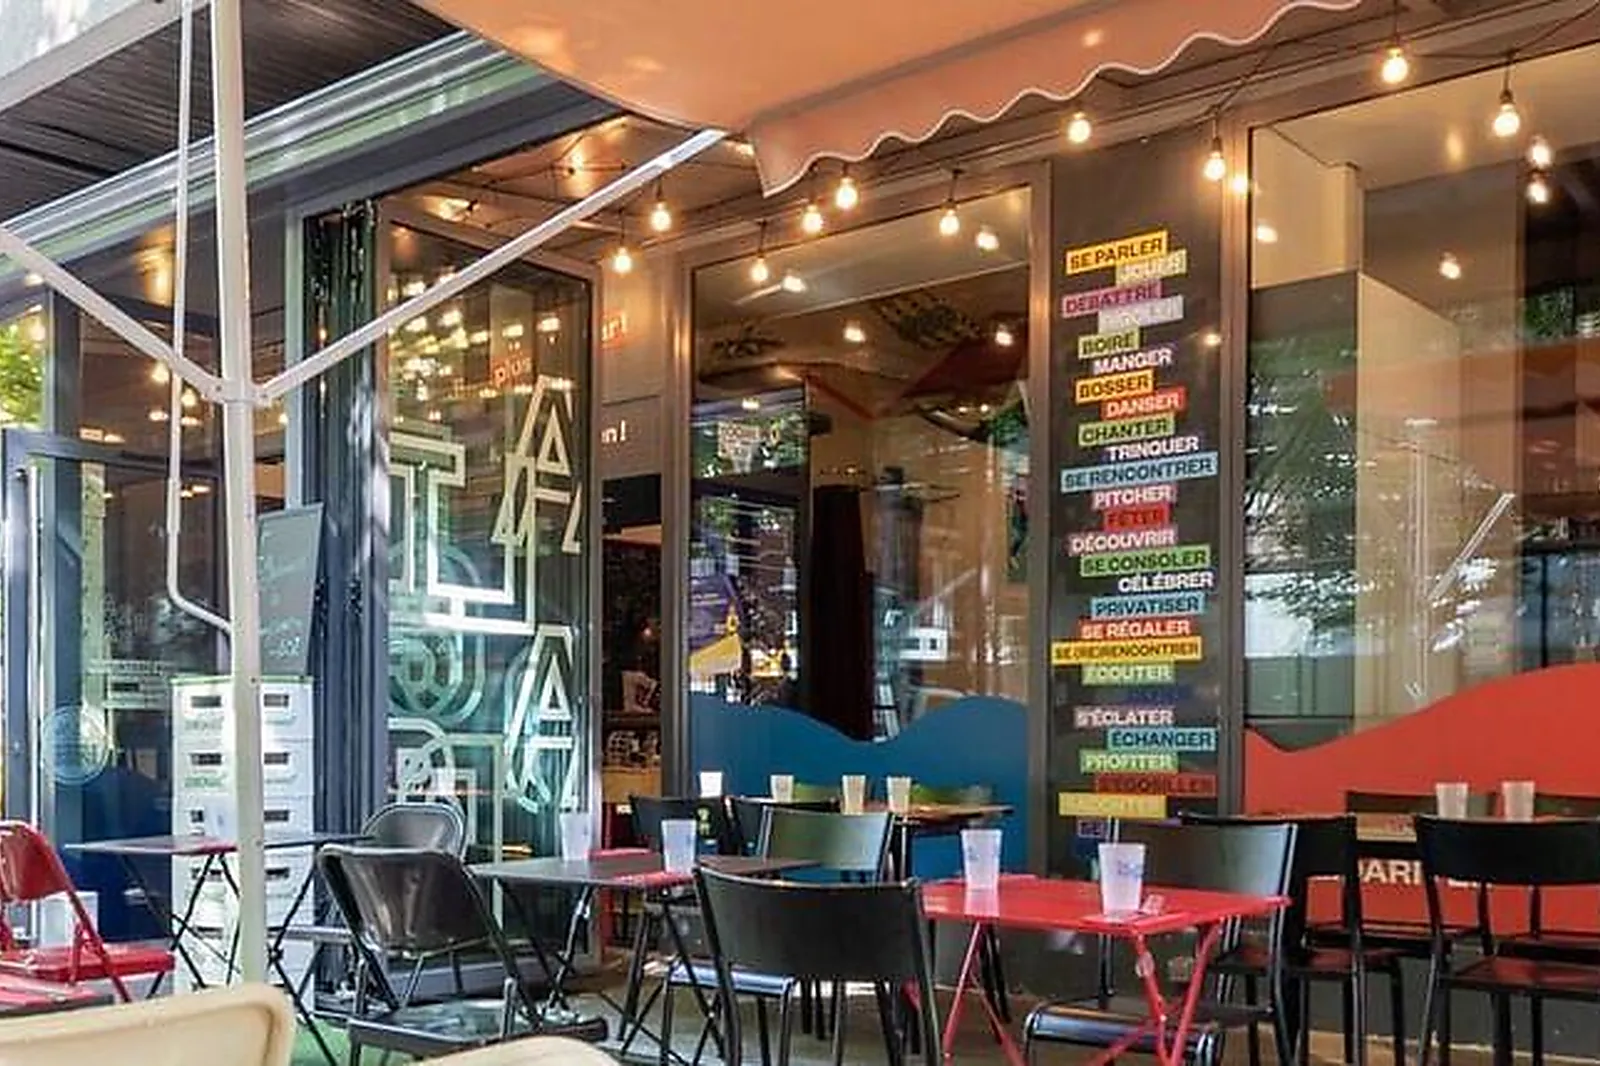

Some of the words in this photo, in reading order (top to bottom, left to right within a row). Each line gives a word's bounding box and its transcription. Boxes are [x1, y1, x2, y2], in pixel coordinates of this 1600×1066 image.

[1095, 238, 1163, 263] PARLER
[1083, 331, 1135, 354] BOIRE
[1094, 348, 1173, 374] MANGER
[1079, 376, 1150, 398] BOSSER
[1106, 392, 1179, 417] DANSER
[1082, 418, 1170, 443] CHANTER
[1105, 436, 1199, 461] TRINQUER
[1064, 472, 1087, 488] SE
[1090, 457, 1214, 485] RENCONTRER
[1093, 485, 1175, 509] PITCHER
[1071, 528, 1175, 554] DÉCOUVRIR
[1083, 559, 1106, 573] SE
[1108, 550, 1206, 572] CONSOLER
[1118, 570, 1214, 592] CÉLÉBRER
[1095, 596, 1200, 617] PRIVATISER
[1081, 624, 1104, 639] SE
[1106, 618, 1191, 639] RÉGALER
[1086, 752, 1173, 772] PROFITER
